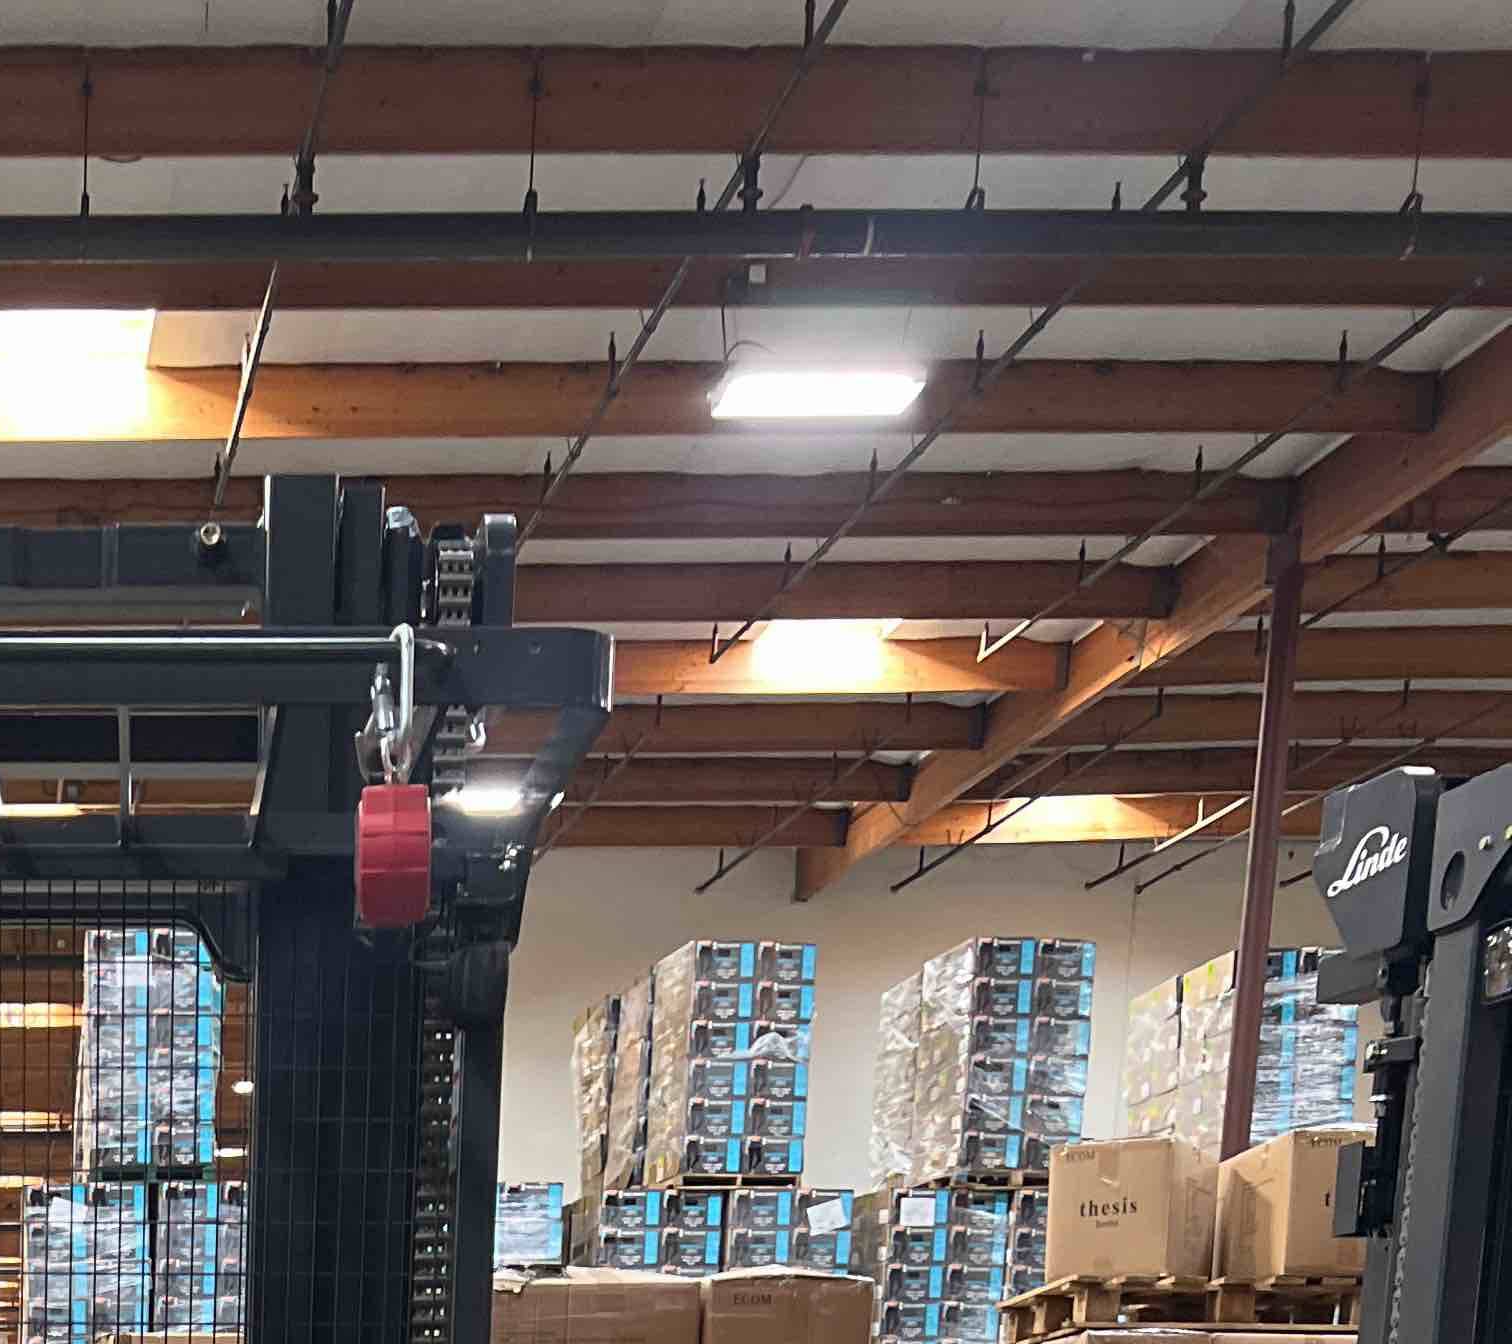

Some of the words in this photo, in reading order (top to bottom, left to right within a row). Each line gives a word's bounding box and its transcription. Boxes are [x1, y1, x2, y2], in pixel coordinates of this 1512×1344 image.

[1327, 825, 1409, 898] Linde
[1080, 1196, 1138, 1218] thesis
[733, 1293, 773, 1305] ECOM
